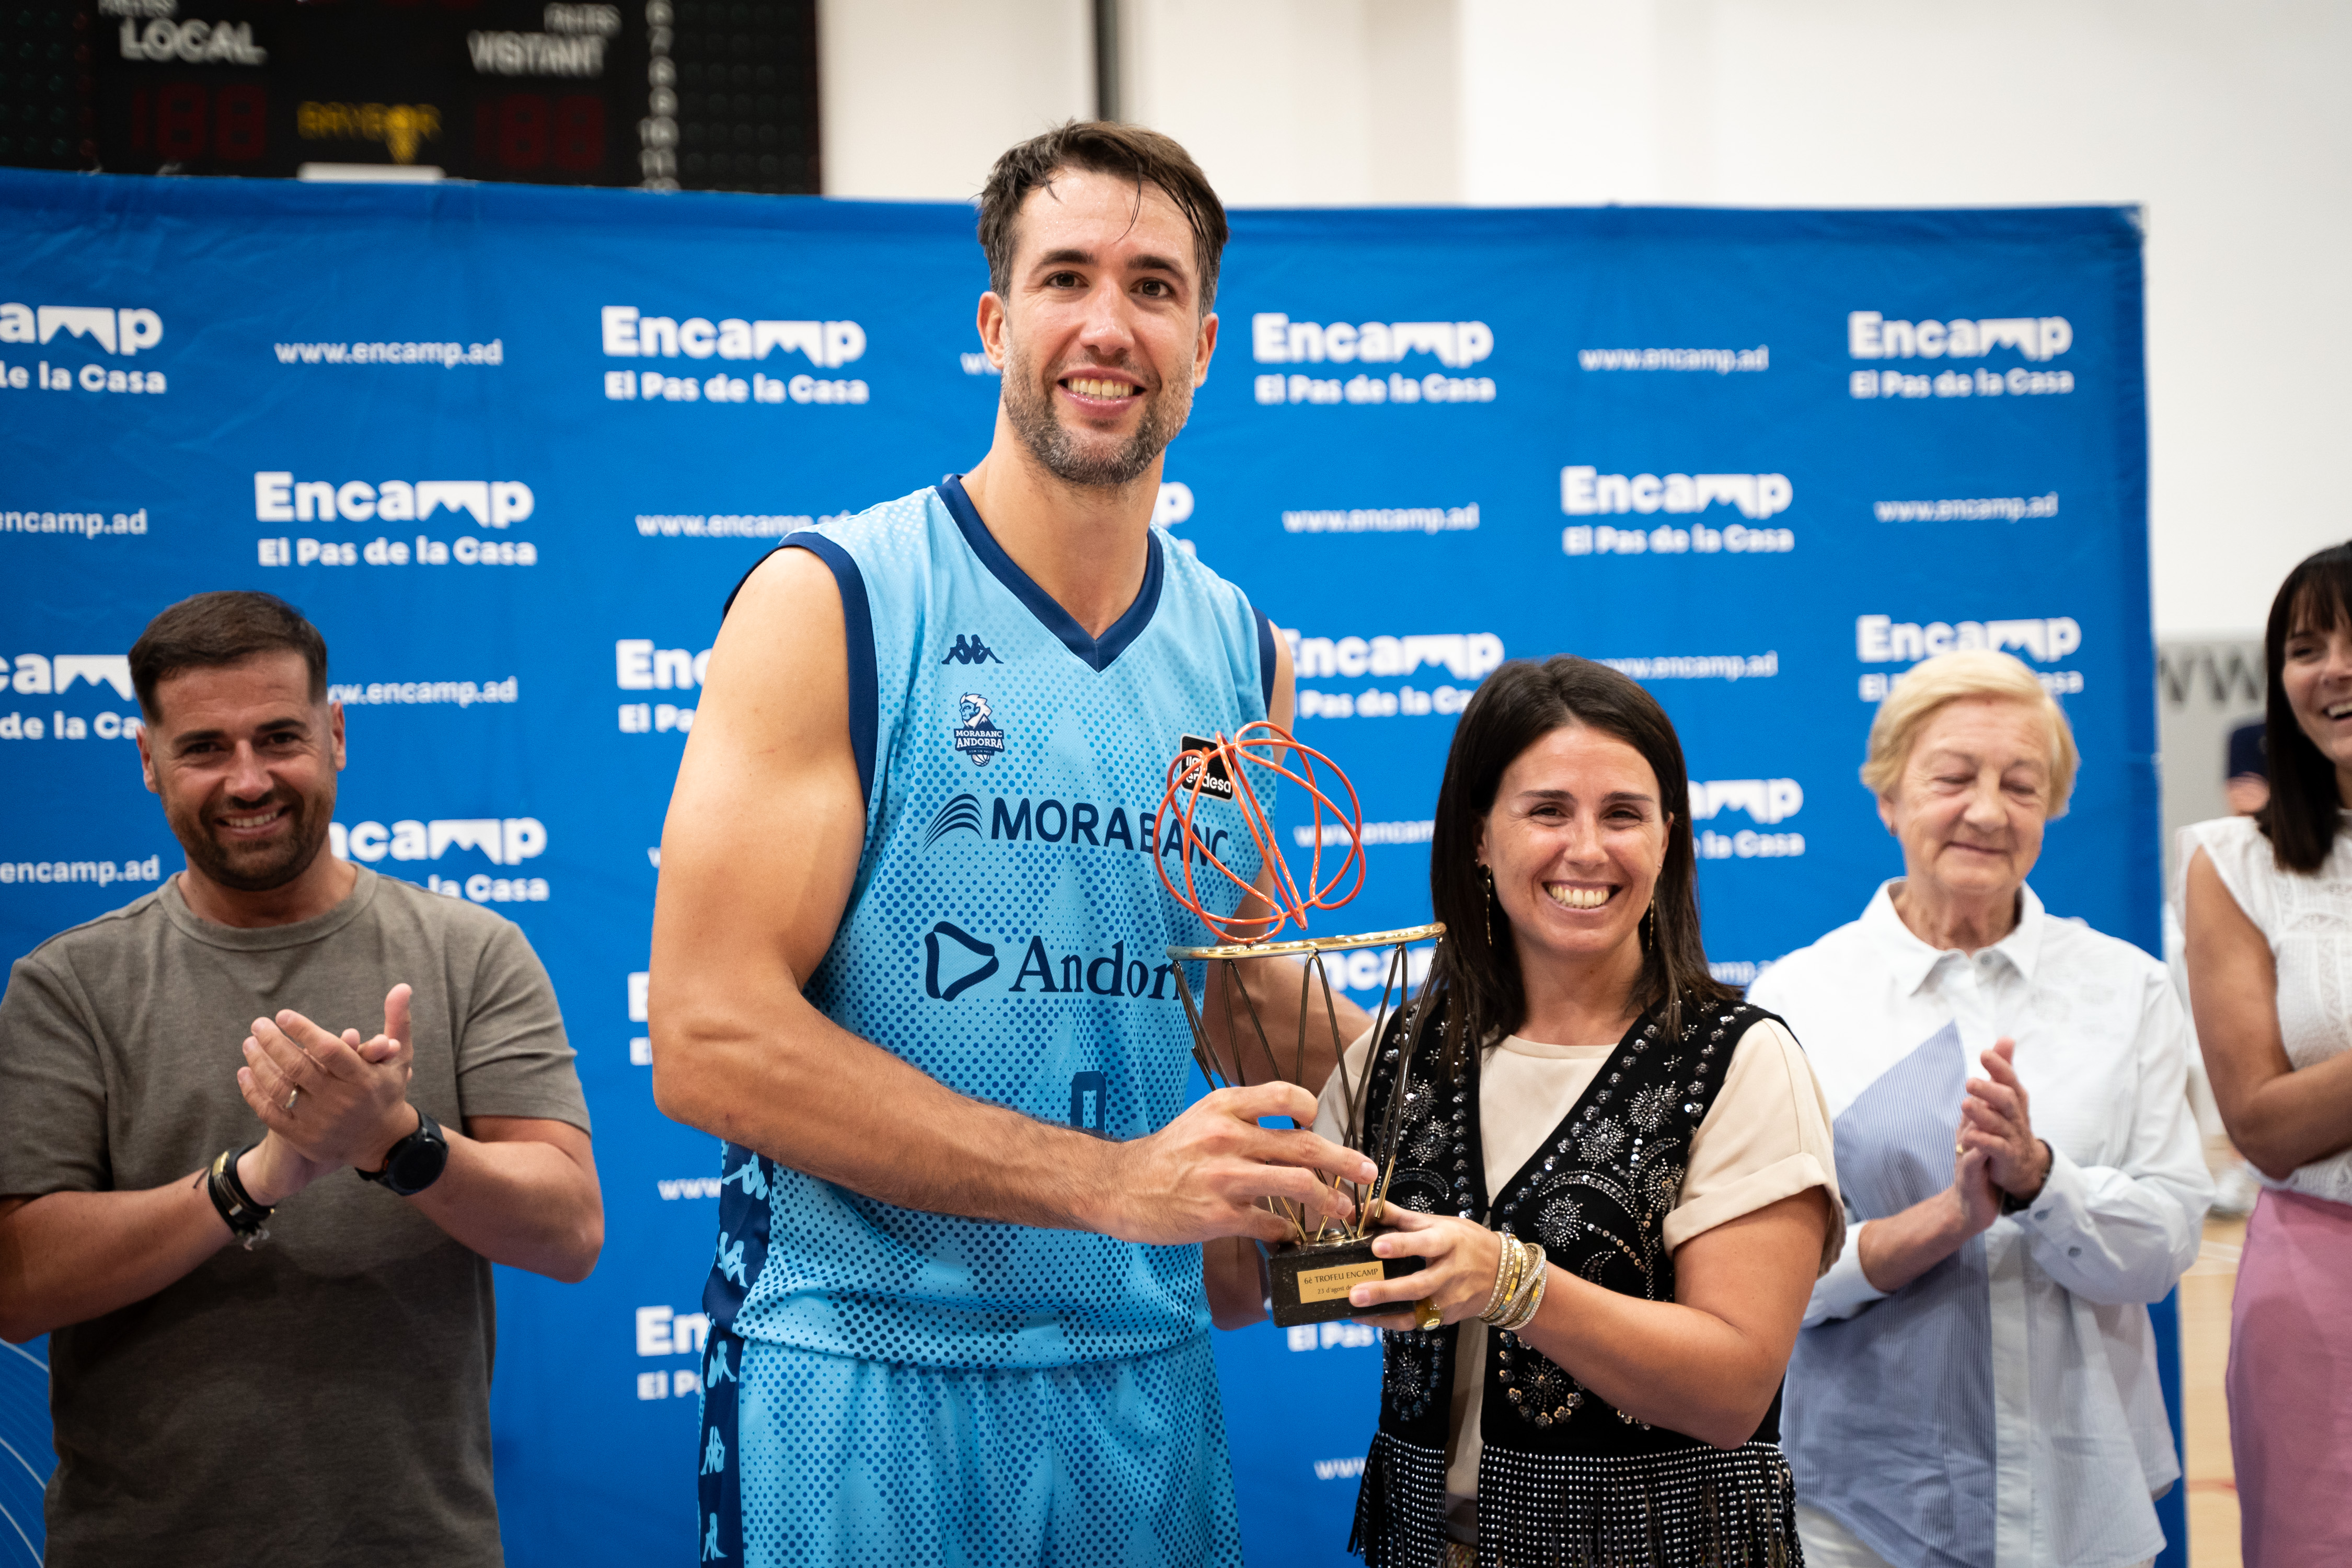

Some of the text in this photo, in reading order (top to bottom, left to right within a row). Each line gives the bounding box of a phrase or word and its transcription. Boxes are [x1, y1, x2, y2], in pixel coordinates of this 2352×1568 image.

[120, 18, 269, 65] LOCAL
[602, 306, 867, 368] Encamp
[1252, 313, 1494, 368] Encamp
[1849, 311, 2072, 361] Encamp
[274, 339, 503, 368] www.encamp.ad
[1578, 345, 1769, 374] www.encamp.ad
[39, 361, 71, 390] la
[79, 364, 167, 394] Casa
[604, 370, 870, 404] El Pas de la Casa
[1254, 373, 1496, 404] El Pas de la Casa
[1850, 368, 2074, 398] El Pas de la Casa
[254, 471, 535, 528] Encamp
[1561, 465, 1793, 520] Encamp
[1874, 492, 2058, 522] www.encamp.ad
[1282, 502, 1480, 534] www.encamp.ad
[258, 535, 537, 567] El Pas de la Casa
[1562, 523, 1795, 555] El Pas de la Casa
[1855, 613, 2082, 663] Encamp
[618, 703, 652, 733] El
[1299, 690, 1354, 719] Pas
[1356, 688, 1399, 718] de
[1400, 686, 1432, 716] la
[0, 712, 44, 740] de
[54, 710, 87, 740] la
[956, 737, 1004, 749] ANDORRA
[990, 797, 1228, 866] MORABANC
[1702, 829, 1733, 860] la
[1733, 829, 1806, 859] Casa
[465, 874, 550, 903] Casa
[1315, 1273, 1344, 1283] TROFEU
[1346, 1268, 1378, 1279] ENCAMP
[1326, 1285, 1345, 1294] d'agost
[1287, 1323, 1318, 1352] El
[1320, 1321, 1375, 1350] Pas
[637, 1370, 668, 1400] El
